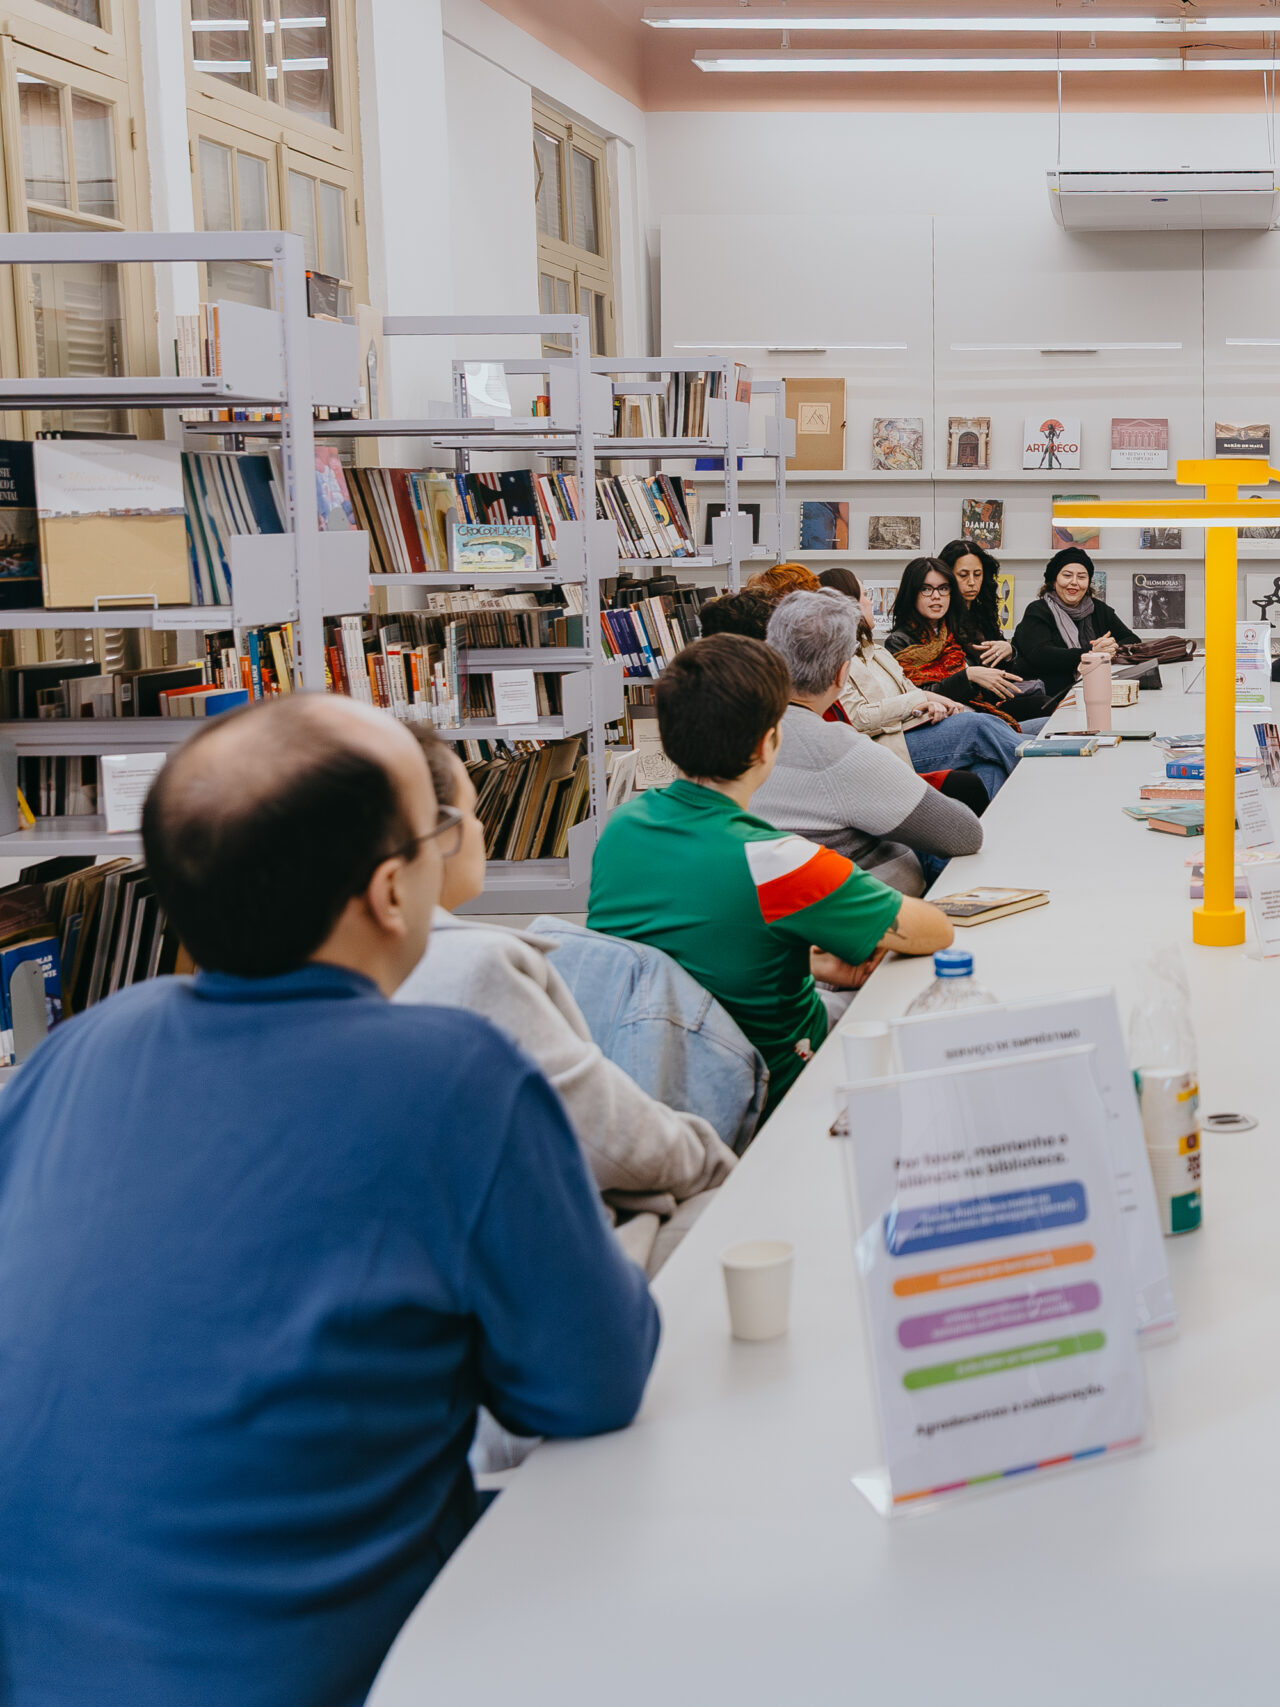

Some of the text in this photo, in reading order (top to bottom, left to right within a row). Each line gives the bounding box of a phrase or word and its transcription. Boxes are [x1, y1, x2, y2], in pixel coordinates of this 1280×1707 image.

[1025, 443, 1046, 453] ART
[965, 520, 1000, 529] DJANIRA
[458, 525, 531, 537] CROCODILAGEM
[1136, 574, 1179, 588] QUILOMBOLAS
